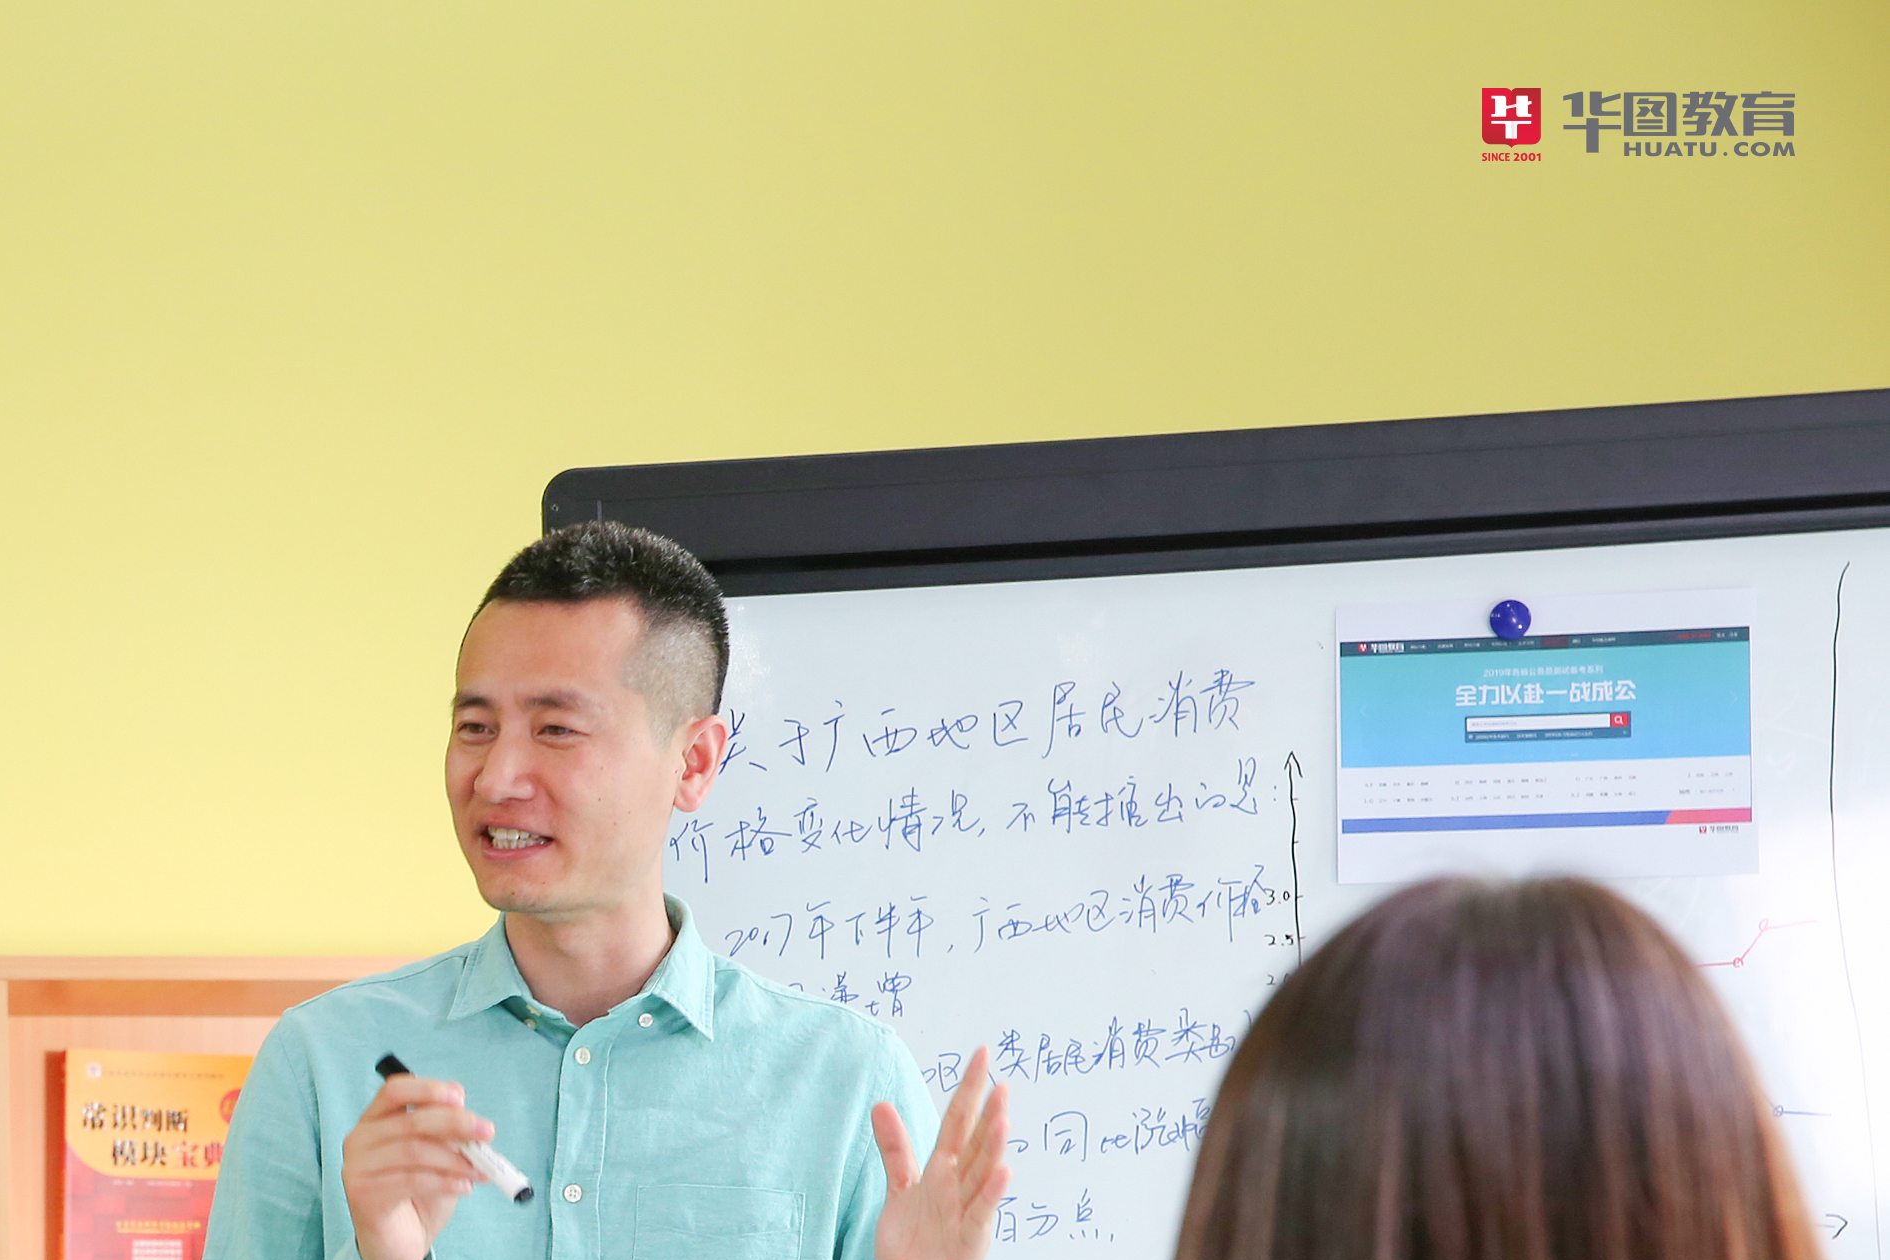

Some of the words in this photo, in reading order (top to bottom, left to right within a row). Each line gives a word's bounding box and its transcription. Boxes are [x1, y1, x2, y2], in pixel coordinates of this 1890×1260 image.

[1455, 680, 1636, 706] 全力以赴一战成公
[719, 668, 1255, 773] 关于广西地区居民消费
[1264, 888, 1290, 906] 3.0
[1264, 934, 1294, 946] 2.5
[81, 1102, 189, 1133] 常识判断
